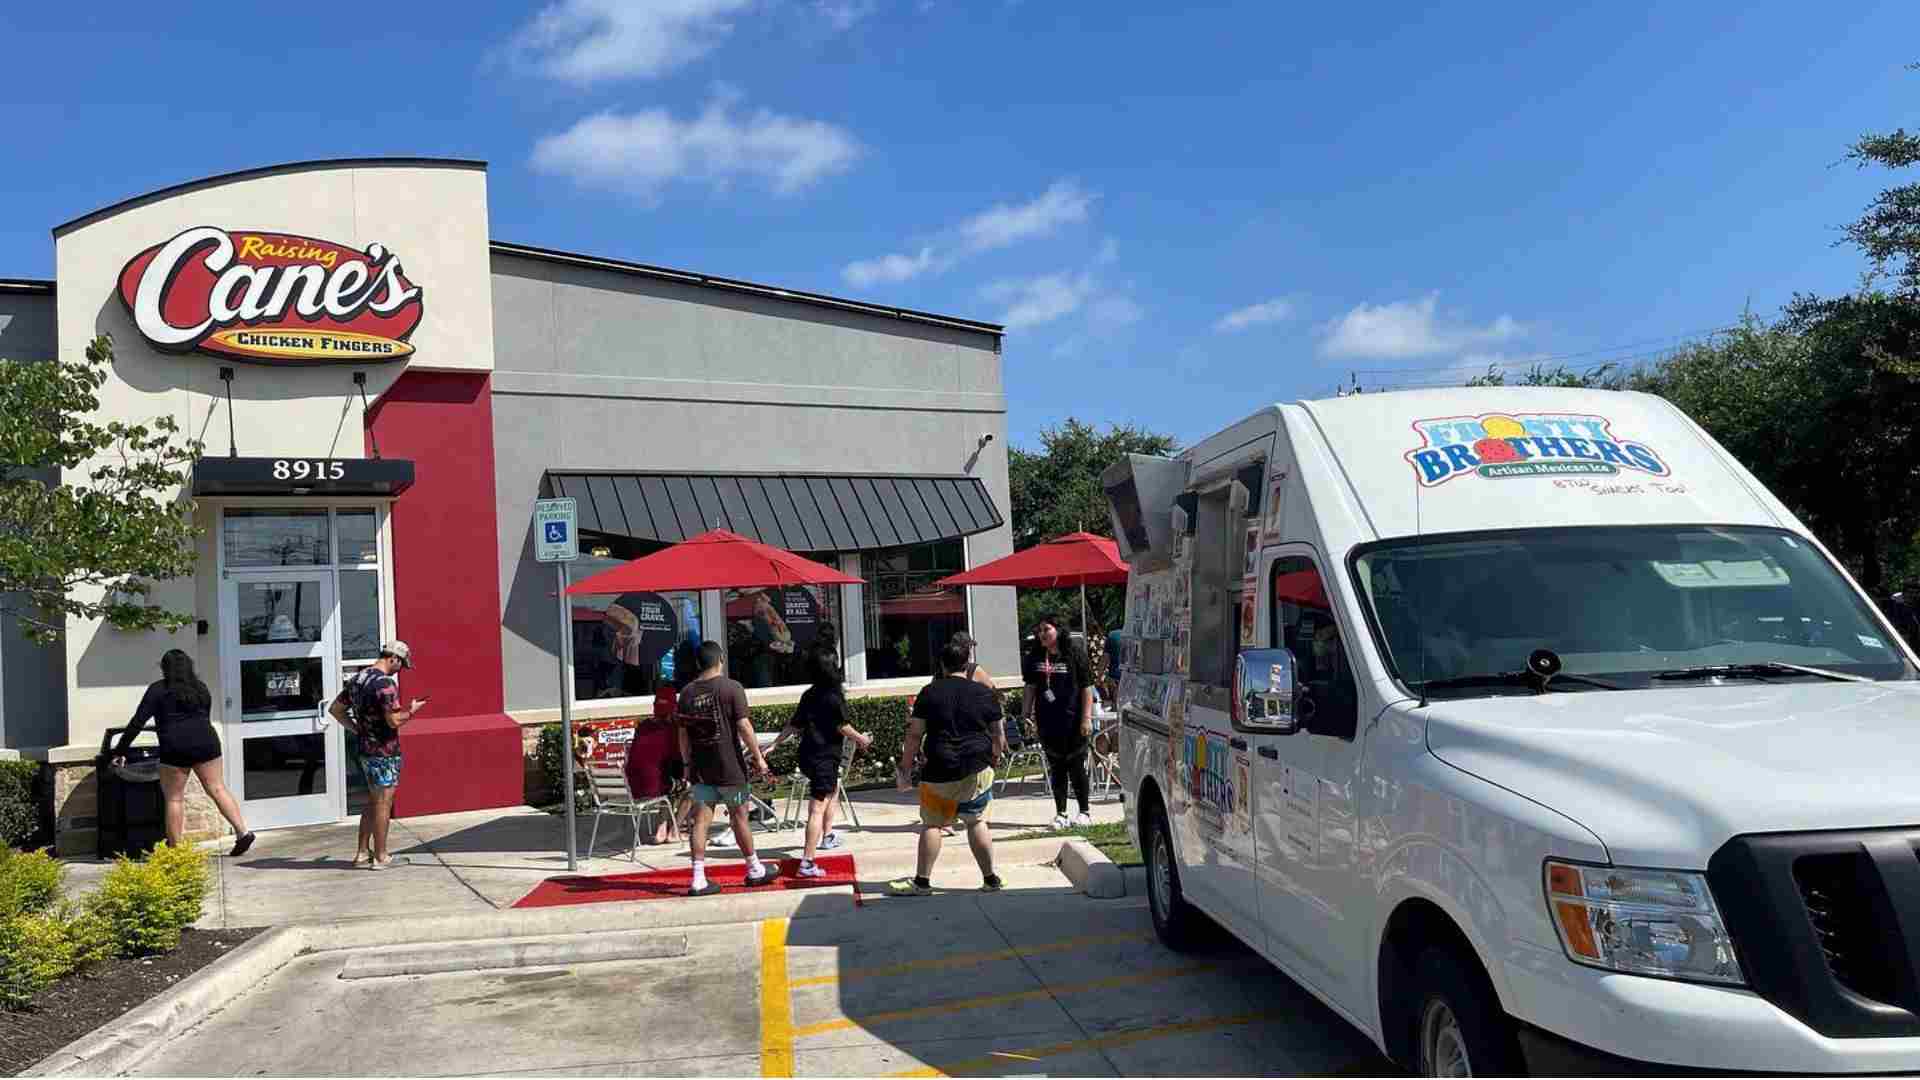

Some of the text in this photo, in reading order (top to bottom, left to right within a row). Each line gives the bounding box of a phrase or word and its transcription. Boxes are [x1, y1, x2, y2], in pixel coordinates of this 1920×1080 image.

[240, 235, 338, 268] Raising
[134, 225, 418, 344] Cane's
[237, 332, 393, 354] CHICKEN FINGERS
[1424, 416, 1611, 446] FROSTY
[272, 459, 345, 480] 8915
[1414, 437, 1664, 482] BROTHERS
[1488, 463, 1533, 477] Artisan
[1535, 462, 1590, 474] Mexican
[538, 511, 572, 521] PARKING
